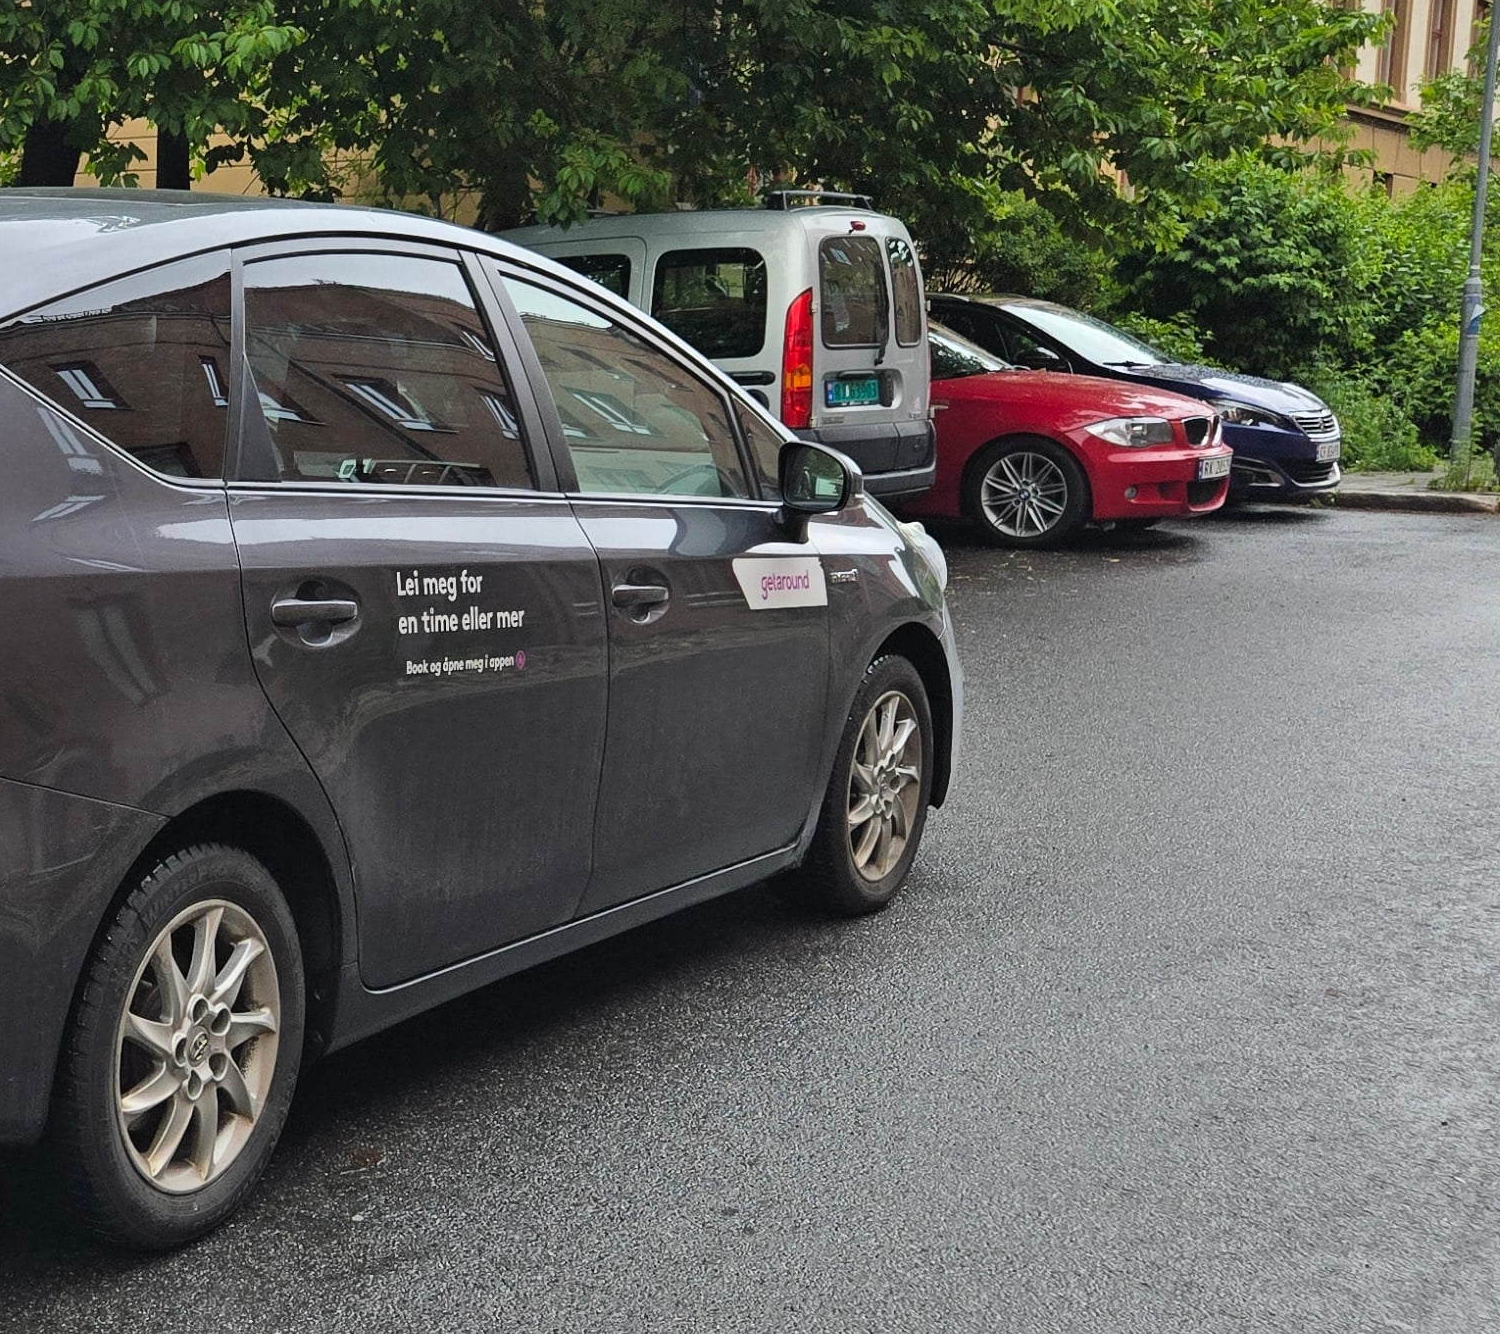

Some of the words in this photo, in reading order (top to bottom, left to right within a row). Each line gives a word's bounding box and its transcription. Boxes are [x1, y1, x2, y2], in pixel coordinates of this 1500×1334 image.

[396, 569, 420, 597] Lei
[423, 576, 458, 603] meg
[459, 569, 484, 594] for
[761, 569, 811, 601] getaround
[398, 615, 419, 635] en
[421, 606, 459, 634] time
[461, 605, 494, 631] eller
[496, 609, 526, 629] mer
[406, 659, 429, 675] Book
[429, 661, 442, 677] og
[442, 656, 465, 676] åpne
[465, 657, 484, 673] meg
[484, 653, 489, 669] i
[489, 655, 515, 672] appen
